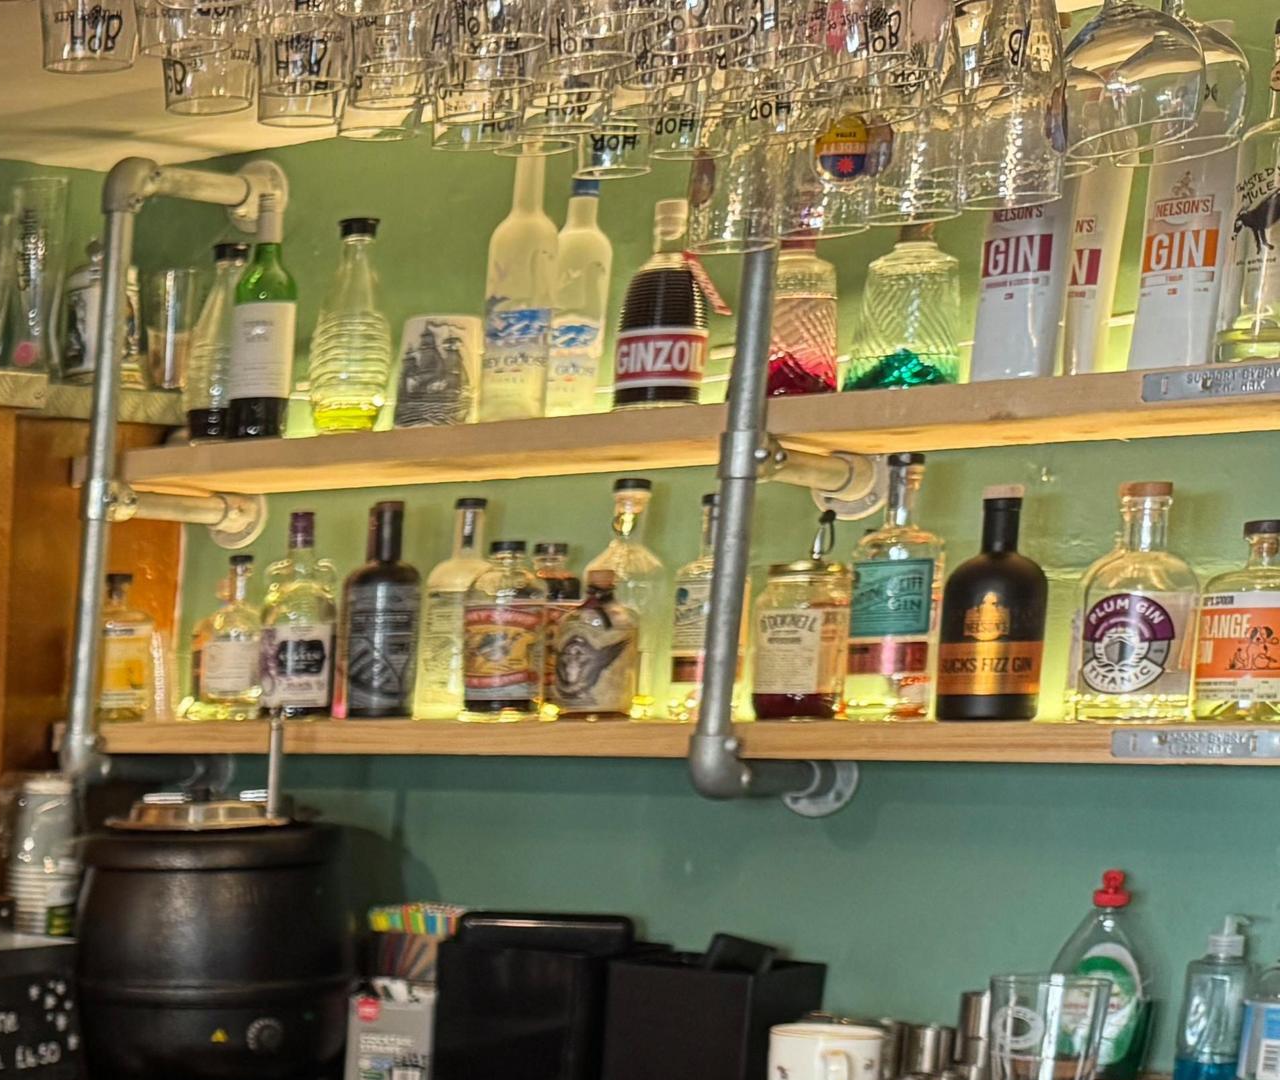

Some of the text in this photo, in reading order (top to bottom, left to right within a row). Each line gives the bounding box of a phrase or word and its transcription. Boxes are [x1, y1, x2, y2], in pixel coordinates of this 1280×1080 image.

[1156, 199, 1210, 218] NELSON'S
[988, 234, 1041, 276] GIN
[1150, 229, 1207, 271] GIN
[617, 339, 707, 374] GINZOIL
[1089, 598, 1165, 625] PLUM GIN
[981, 657, 1009, 673] FIZZ
[1011, 656, 1033, 673] GIN
[1089, 664, 1151, 686] TITANIC
